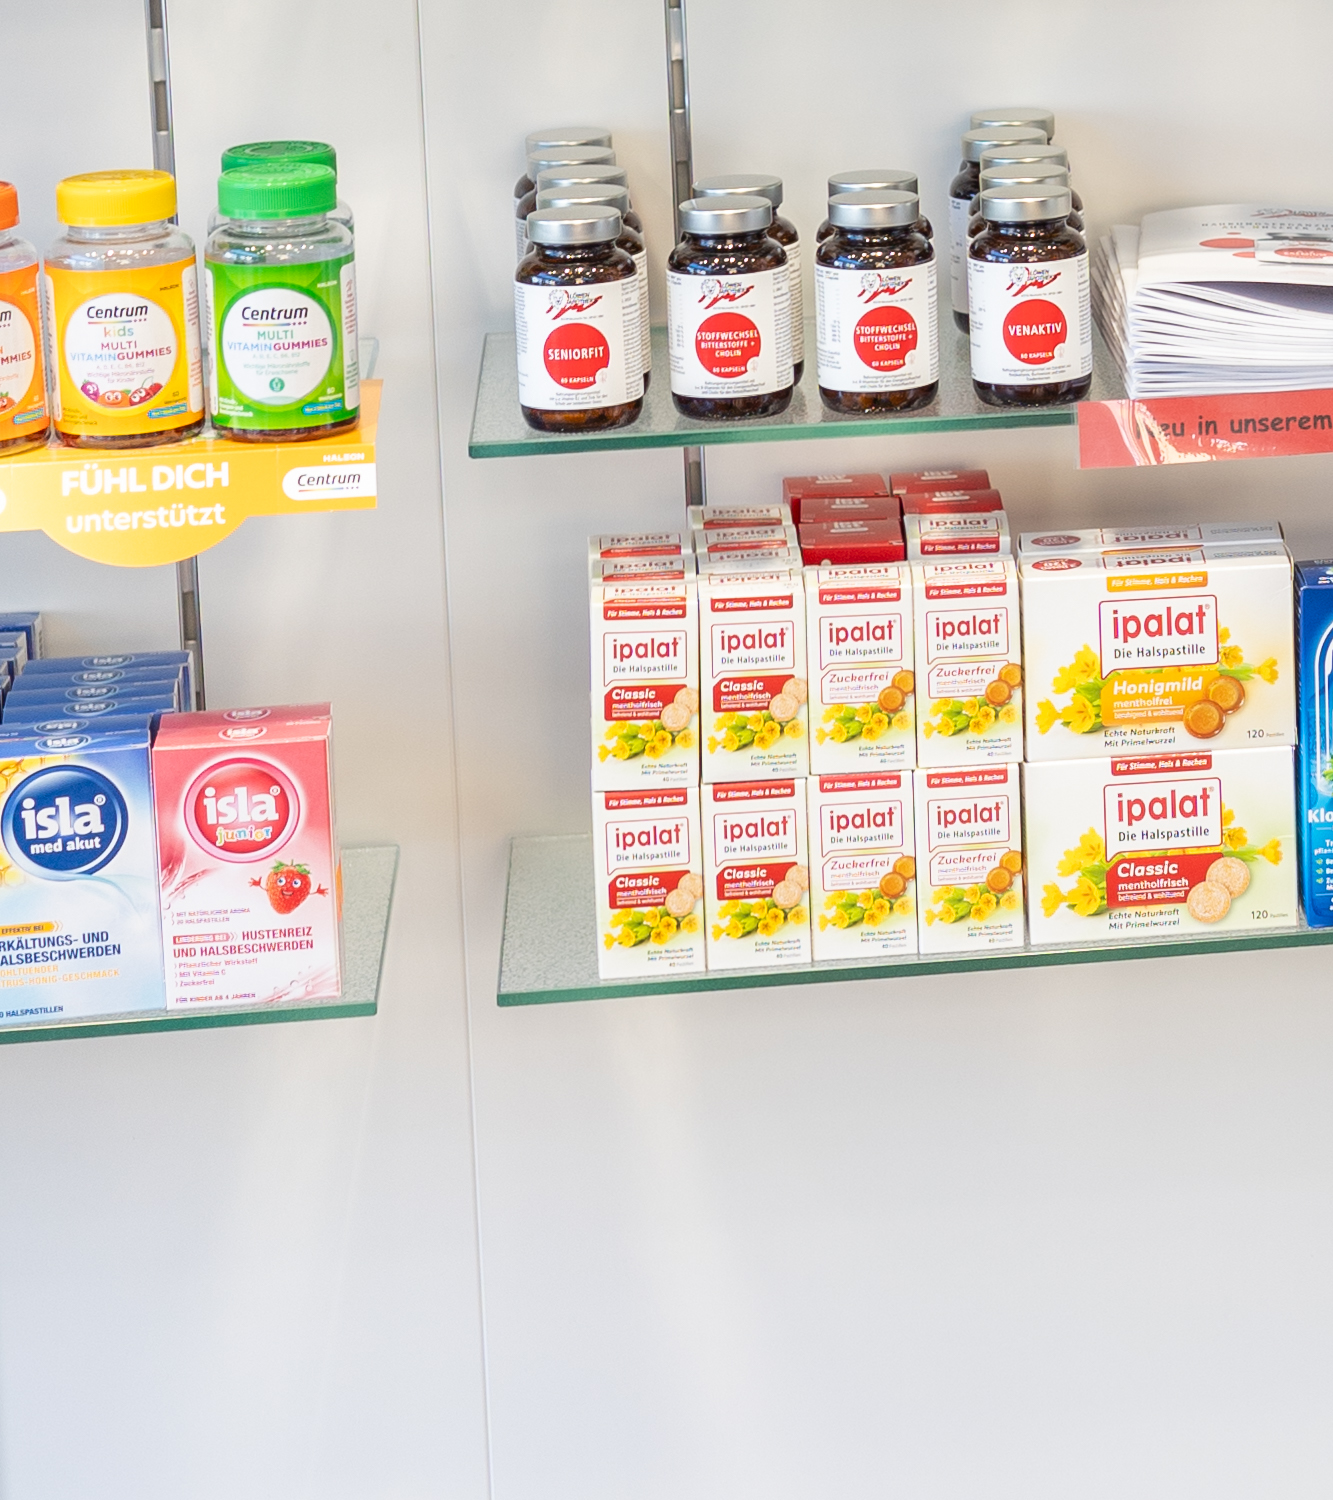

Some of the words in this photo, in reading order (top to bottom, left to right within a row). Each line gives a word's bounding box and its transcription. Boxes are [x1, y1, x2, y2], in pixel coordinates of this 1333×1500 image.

[87, 303, 148, 319] Centrum
[241, 305, 309, 321] Centrum
[104, 325, 134, 338] kids
[257, 329, 294, 340] MULTI
[1008, 322, 1062, 336] VENAKTIV
[100, 340, 137, 351] MULTI
[548, 345, 604, 361] SENIORFIT
[1199, 416, 1217, 435] in
[1231, 411, 1332, 434] unserem
[61, 463, 146, 496] FÜHL
[153, 462, 229, 489] DICH
[297, 471, 361, 488] Centrum
[66, 504, 226, 534] unterstützt
[828, 618, 894, 645] ipalat
[1113, 604, 1206, 643] ipalat
[613, 637, 679, 662] ipalat
[1114, 647, 1132, 660] Die
[1136, 644, 1205, 659] Halspastille
[829, 672, 889, 684] Zuckerfrei
[1113, 677, 1202, 695] Honigmild
[612, 688, 655, 700] Classic
[204, 786, 279, 823] isla
[1118, 787, 1210, 826] ipalat
[22, 795, 105, 840] isla
[216, 826, 272, 846] junior
[31, 841, 62, 855] med
[67, 837, 101, 852] akut
[1118, 861, 1177, 878] Classic
[242, 926, 312, 940] HUSTENREIZ
[173, 946, 196, 958] UND
[200, 940, 314, 956] HALSBESCHWERDEN
